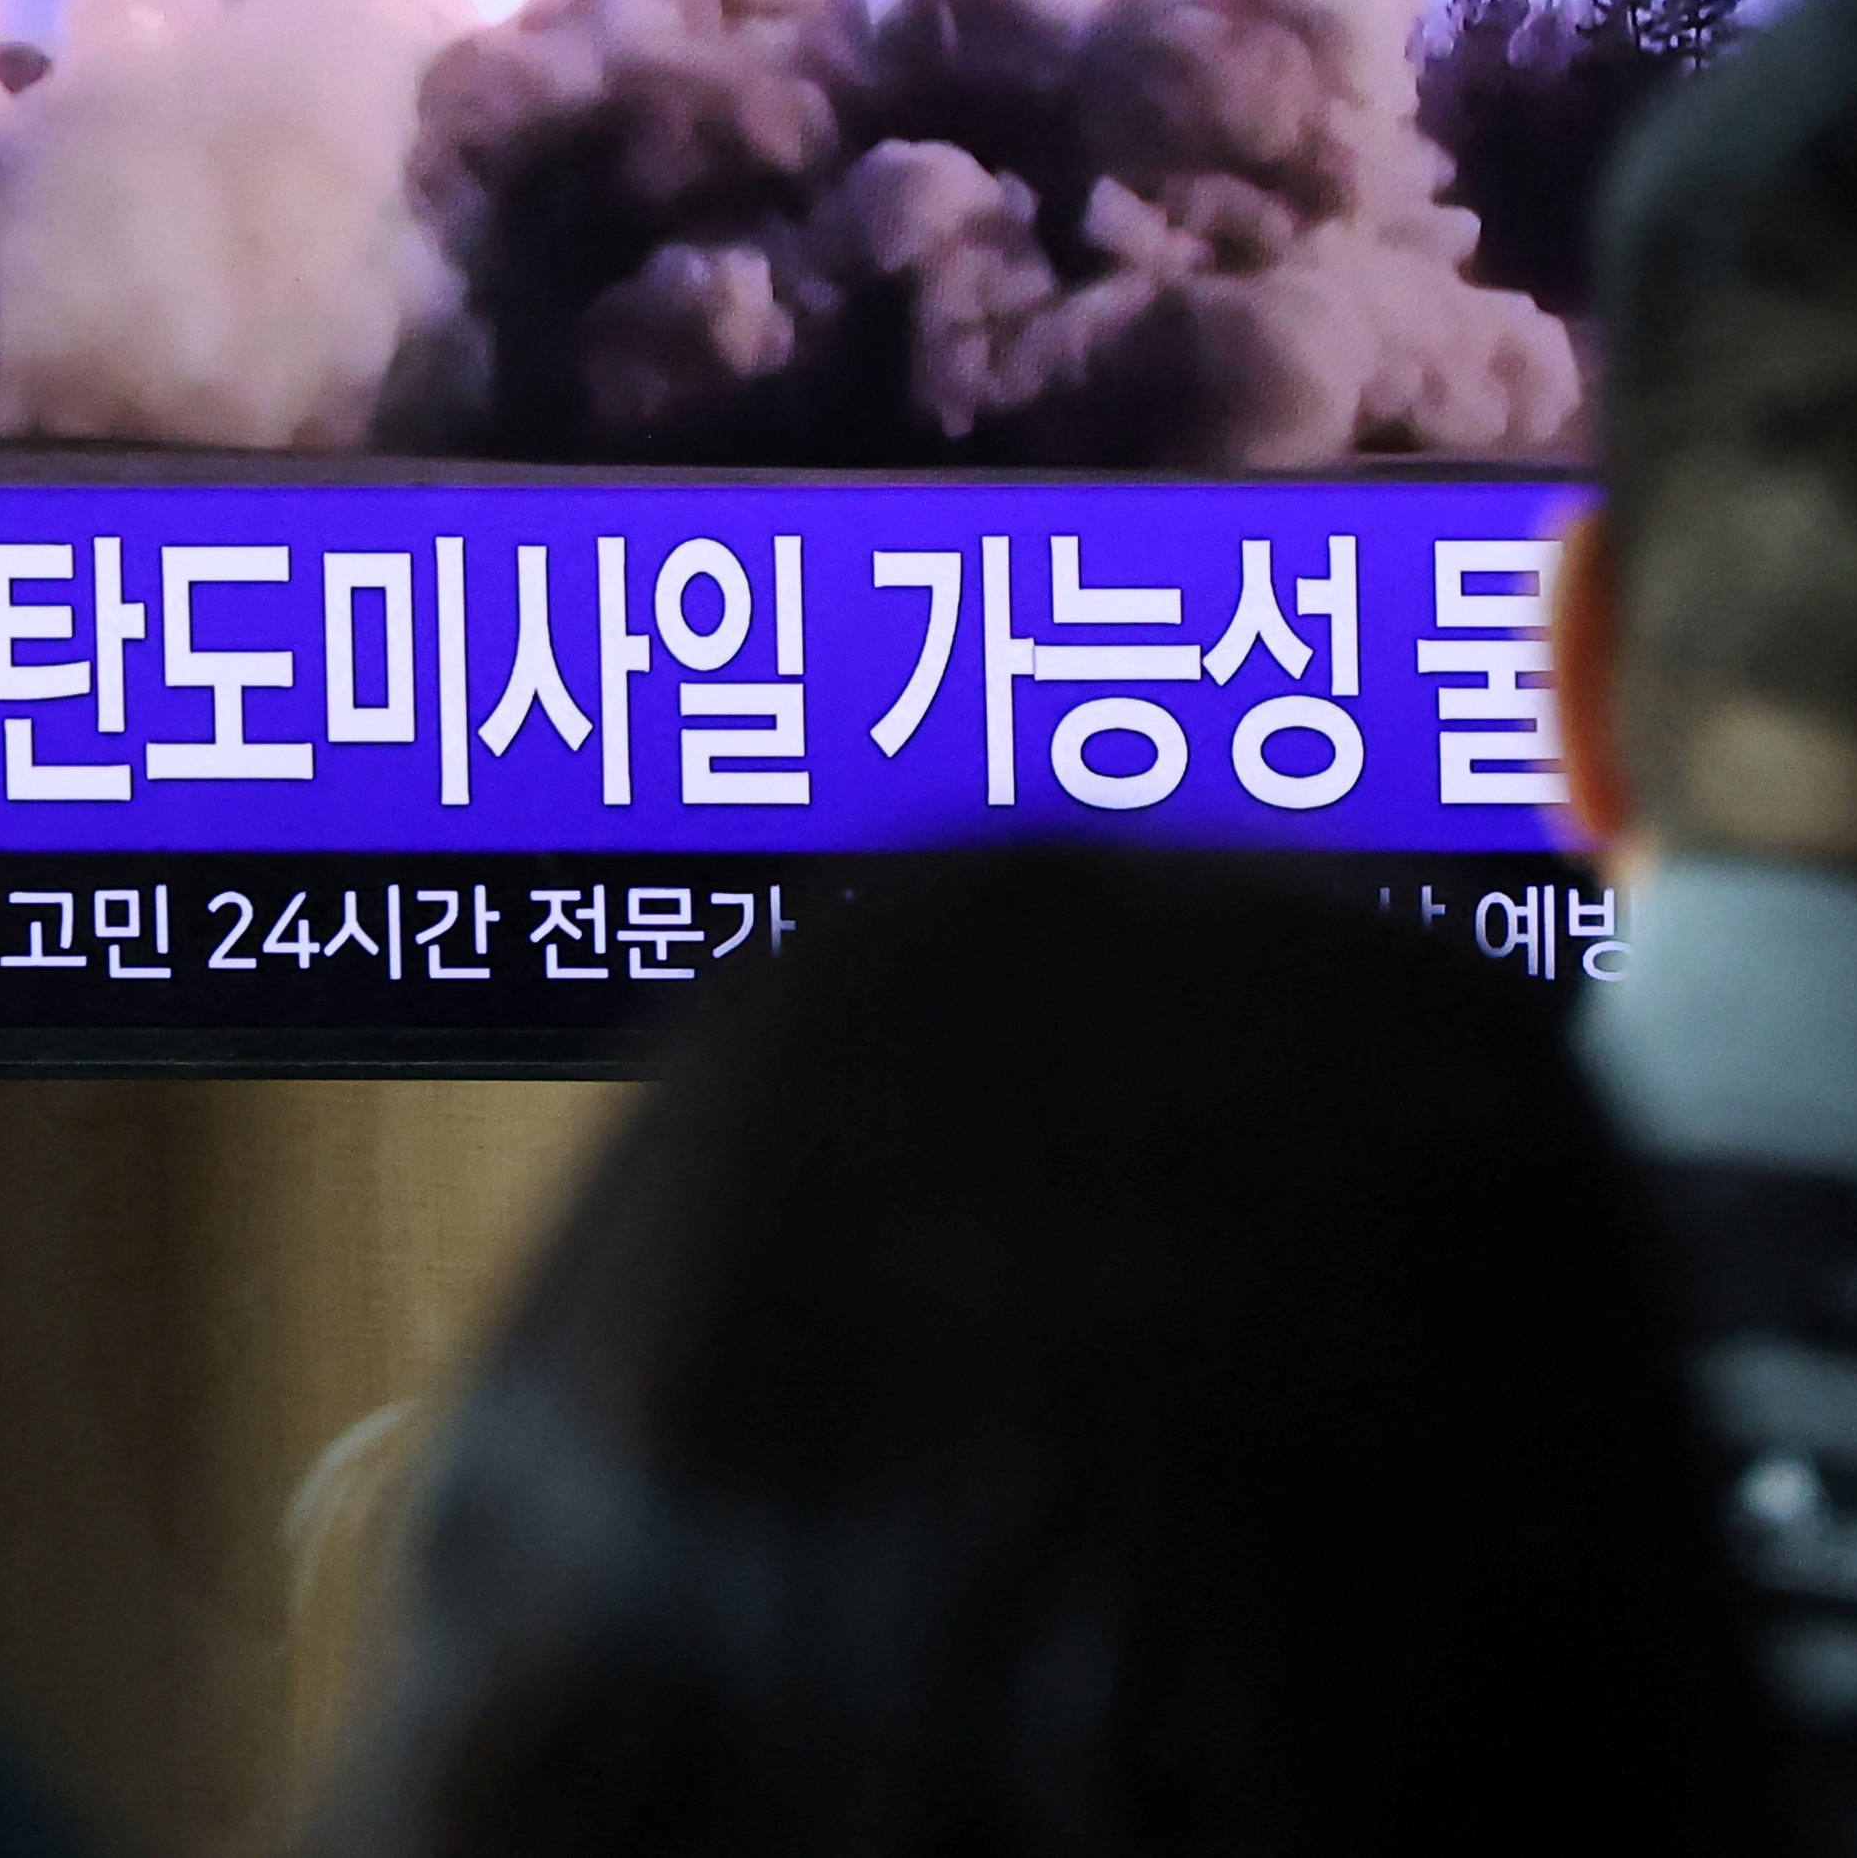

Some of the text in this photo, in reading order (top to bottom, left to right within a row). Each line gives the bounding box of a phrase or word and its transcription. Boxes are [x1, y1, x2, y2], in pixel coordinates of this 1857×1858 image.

[869, 535, 1365, 810] 가능성
[0, 884, 172, 980] 고민
[207, 884, 502, 980] 24시간
[529, 883, 797, 980] 전문가
